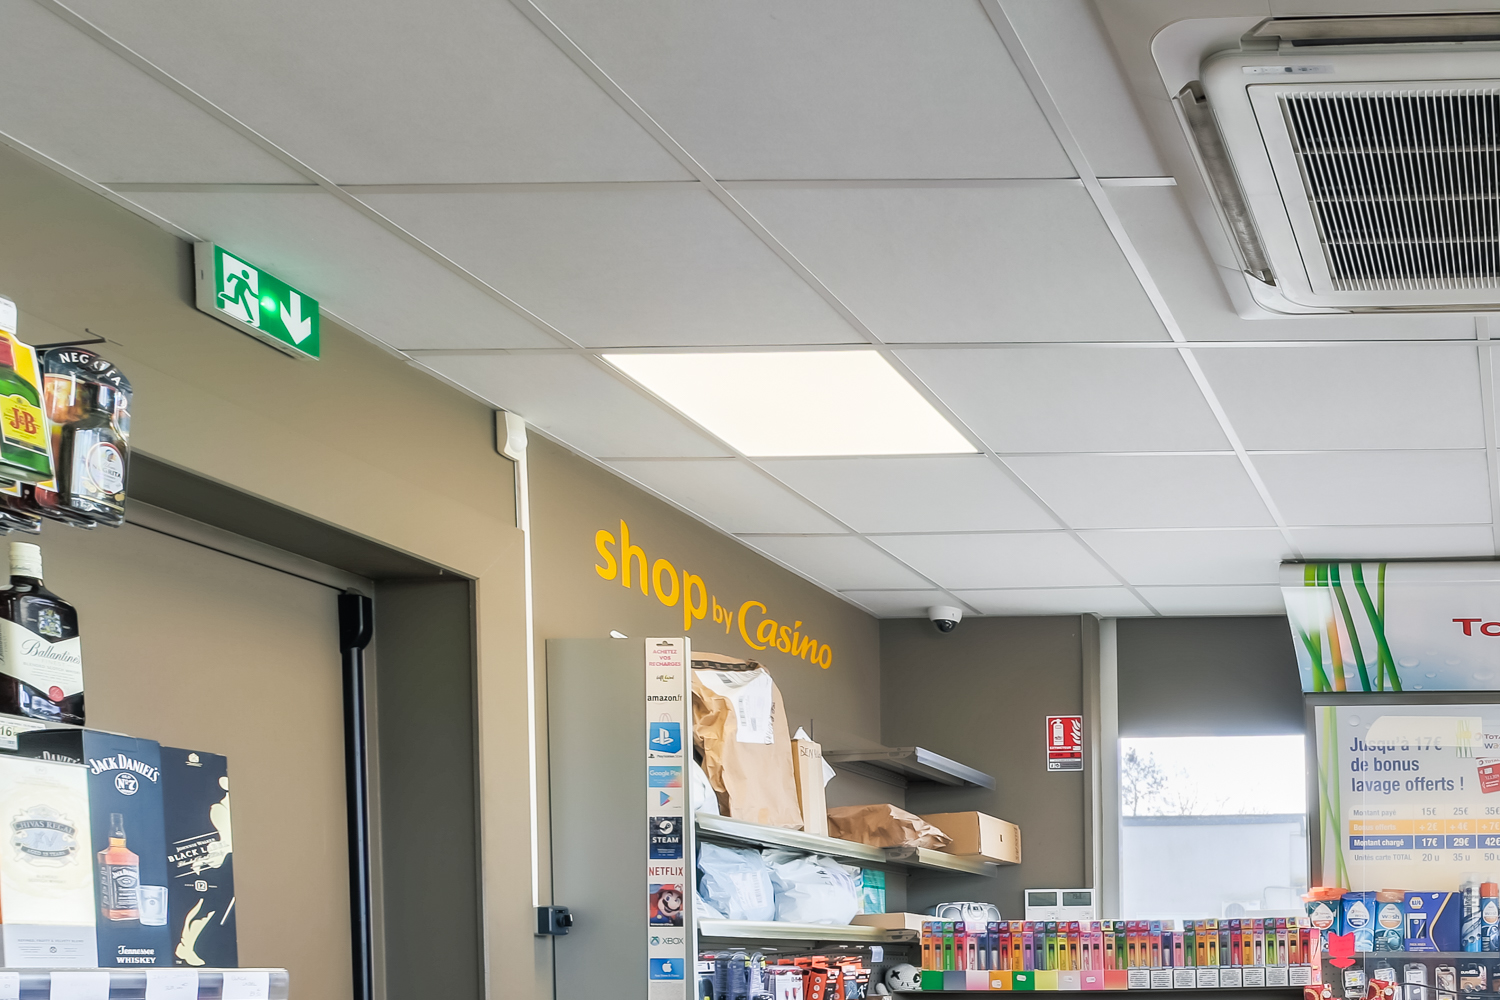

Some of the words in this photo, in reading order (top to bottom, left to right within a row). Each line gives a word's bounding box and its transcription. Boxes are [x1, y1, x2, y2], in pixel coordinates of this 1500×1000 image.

[595, 518, 708, 631] shop
[712, 595, 733, 634] by
[737, 600, 832, 670] Casino
[1415, 736, 1443, 751] 17€
[89, 757, 118, 775] JACK
[118, 753, 160, 784] DANIEL'S
[1351, 757, 1369, 772] de
[1374, 757, 1420, 772] bonus
[649, 769, 669, 777] Google
[1351, 777, 1401, 794] lavage
[1405, 776, 1455, 792] offerts
[1381, 808, 1397, 817] payé
[1421, 807, 1437, 816] 15€
[1453, 807, 1469, 815] 25€
[1485, 806, 1500, 815] 35€
[1374, 823, 1397, 831] offerts
[652, 836, 679, 844] STEAM
[1353, 839, 1381, 847] Montant
[1382, 838, 1405, 847] chargé
[1421, 837, 1438, 847] 17€
[1453, 837, 1470, 847] 29€
[1485, 837, 1500, 846] 42€
[168, 851, 197, 864] BLACK
[1354, 853, 1374, 861] Unités
[1393, 853, 1412, 861] TOTAL
[1422, 853, 1433, 862] 20
[1453, 853, 1464, 861] 35
[1484, 853, 1495, 861] 50
[649, 866, 683, 876] NETFLIX
[662, 937, 684, 945] XBOX
[118, 945, 154, 956] Tennessee
[116, 956, 156, 964] WHISKEY
